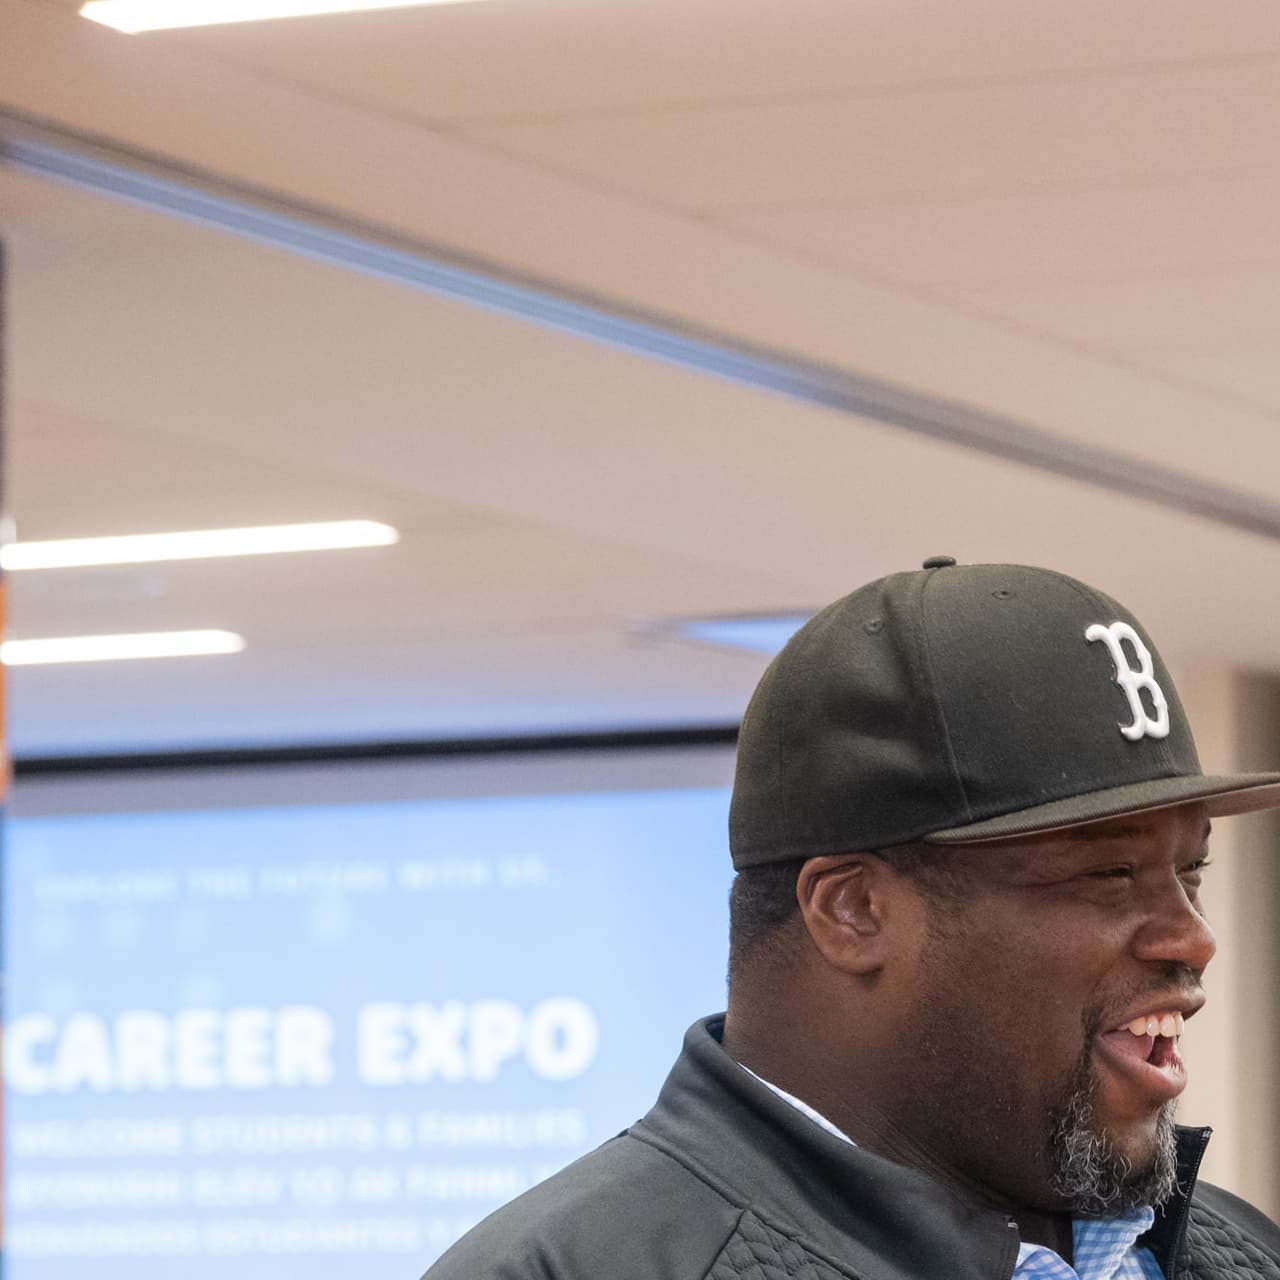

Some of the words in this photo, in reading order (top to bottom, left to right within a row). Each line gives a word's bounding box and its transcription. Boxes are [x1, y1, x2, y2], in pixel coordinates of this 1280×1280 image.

[1085, 621, 1170, 741] B
[3, 1003, 334, 1093] CAREER
[357, 996, 598, 1085] EXPO
